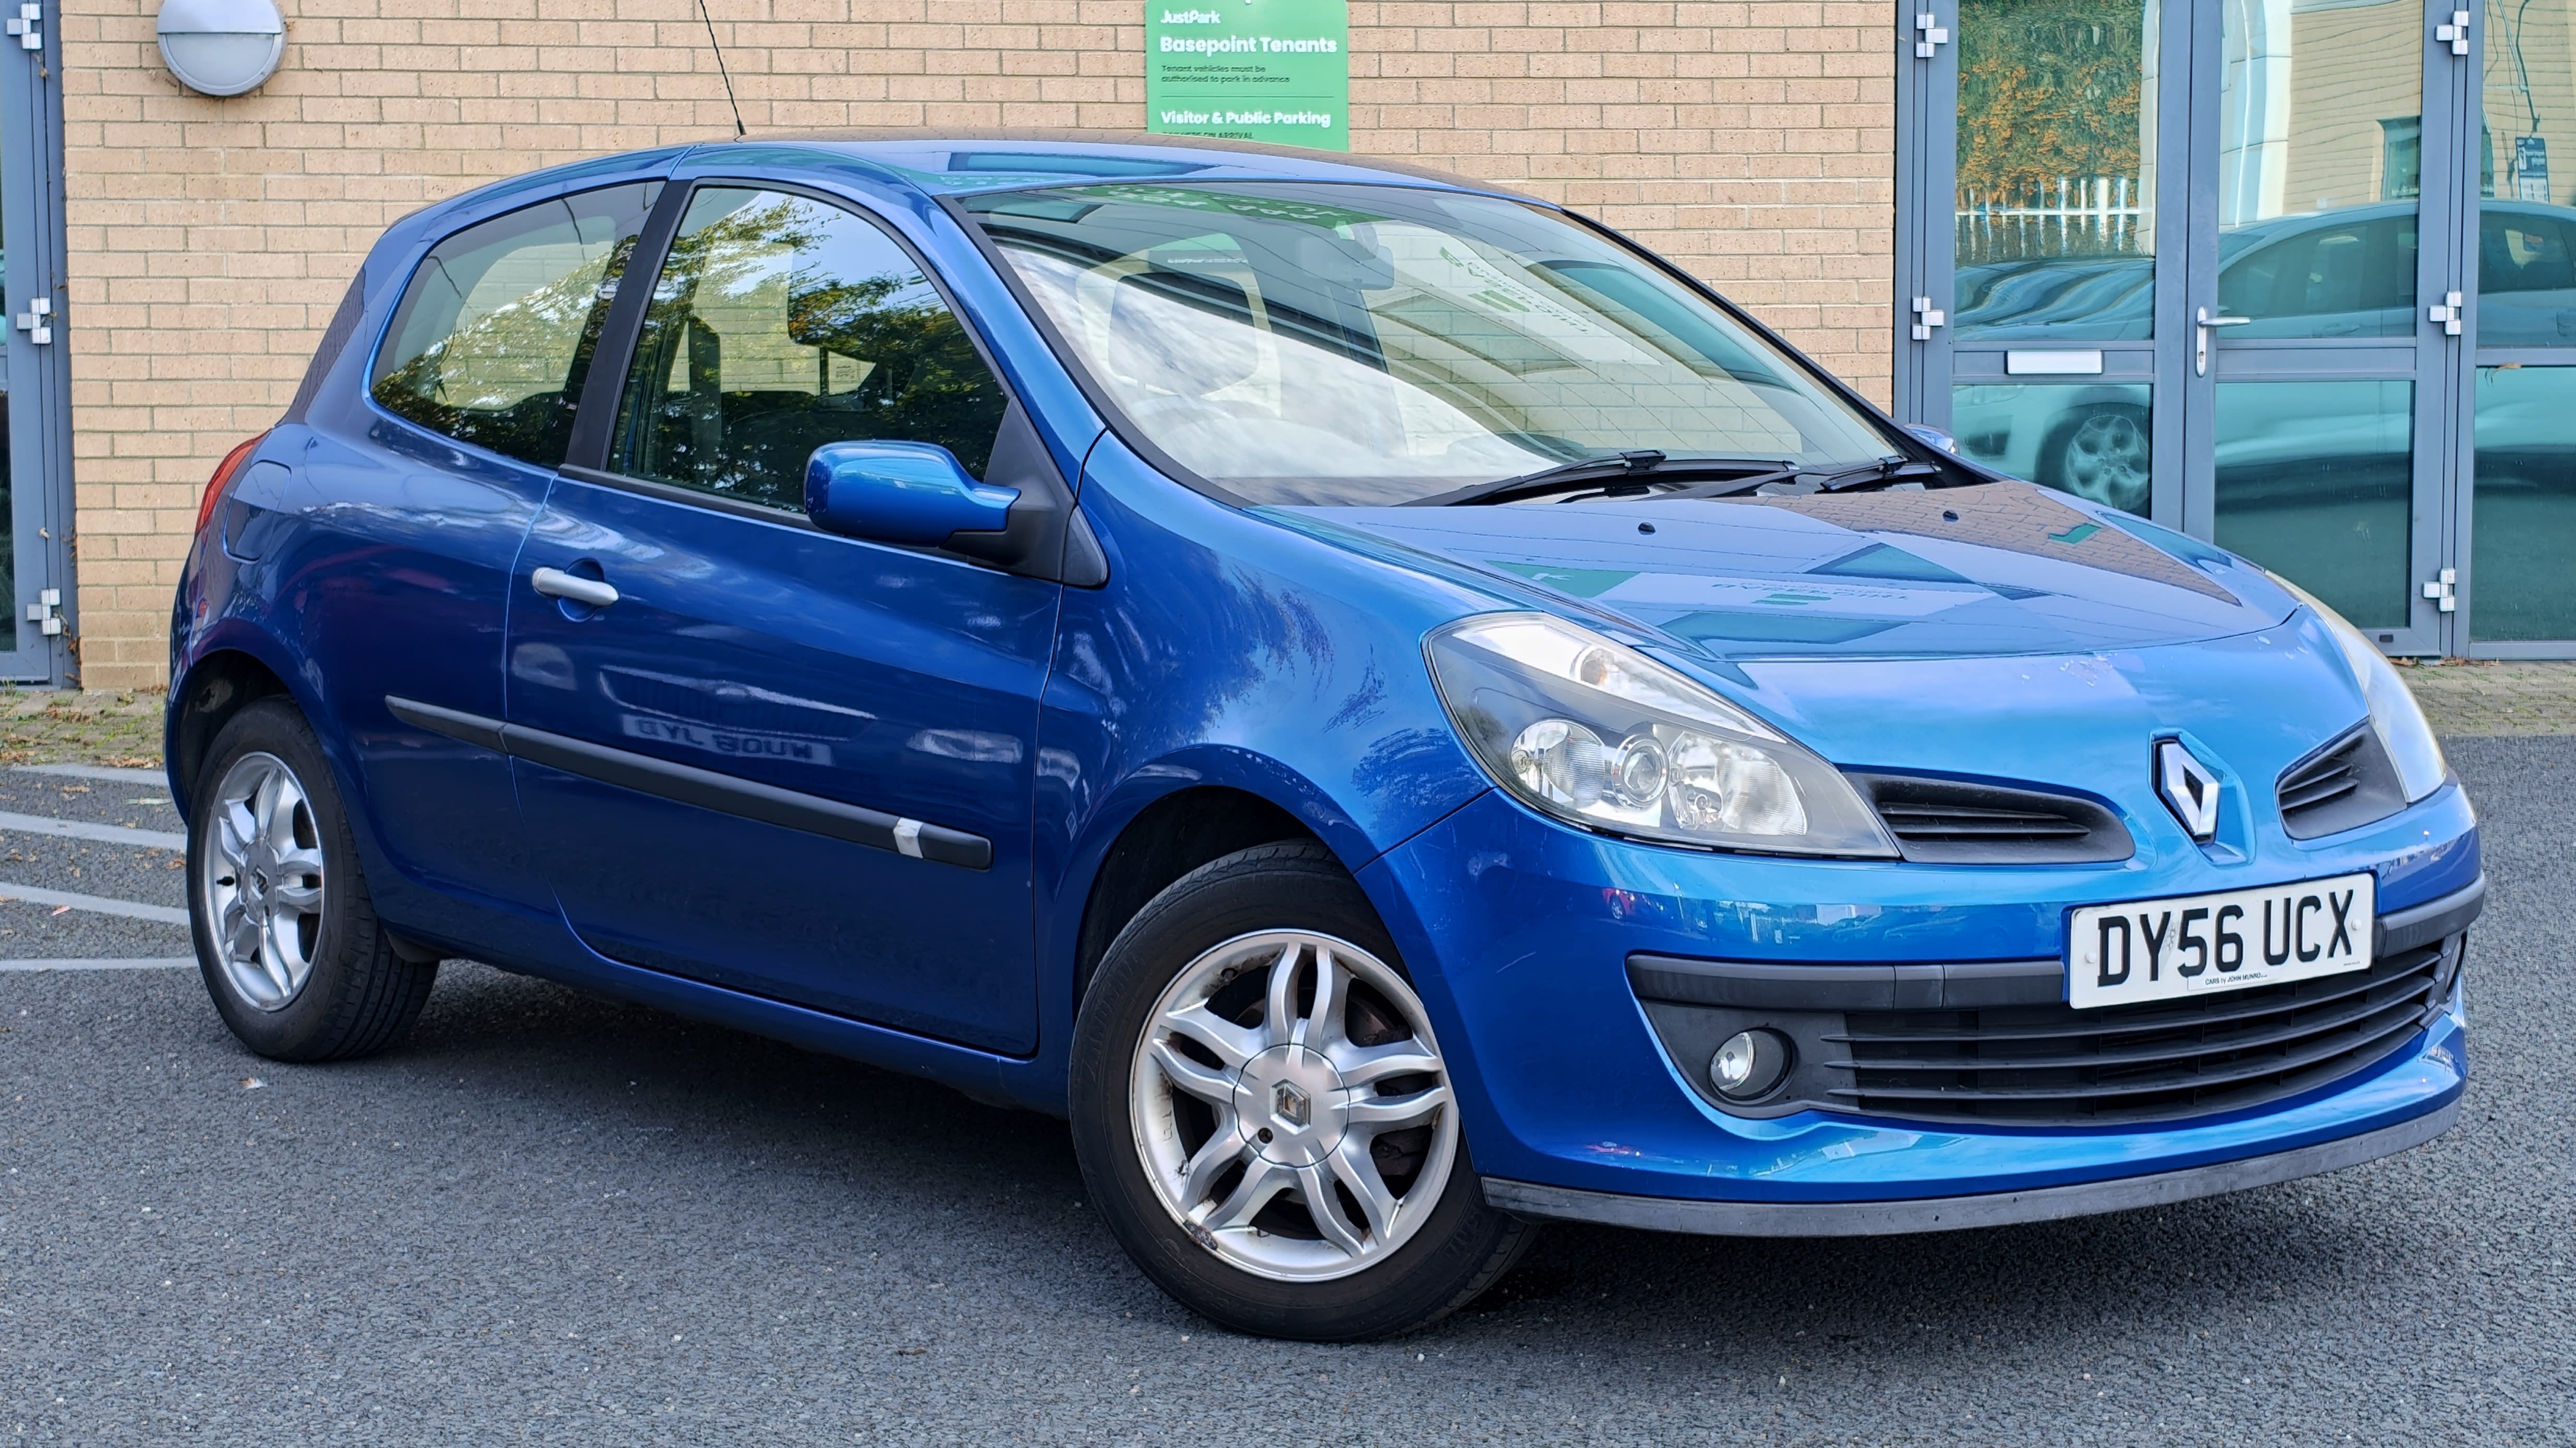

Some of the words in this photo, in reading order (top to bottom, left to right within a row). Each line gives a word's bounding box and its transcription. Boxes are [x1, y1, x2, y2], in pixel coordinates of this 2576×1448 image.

[1160, 9, 1221, 24] JustPark
[1160, 35, 1257, 57] Basepoint
[1260, 37, 1337, 53] Tenants
[1161, 111, 1210, 124] Visitor
[1212, 112, 1224, 124] &
[1226, 111, 1272, 124] Public
[1274, 111, 1331, 128] Parking
[2097, 904, 2244, 988] DY56
[2263, 889, 2354, 967] UCX
